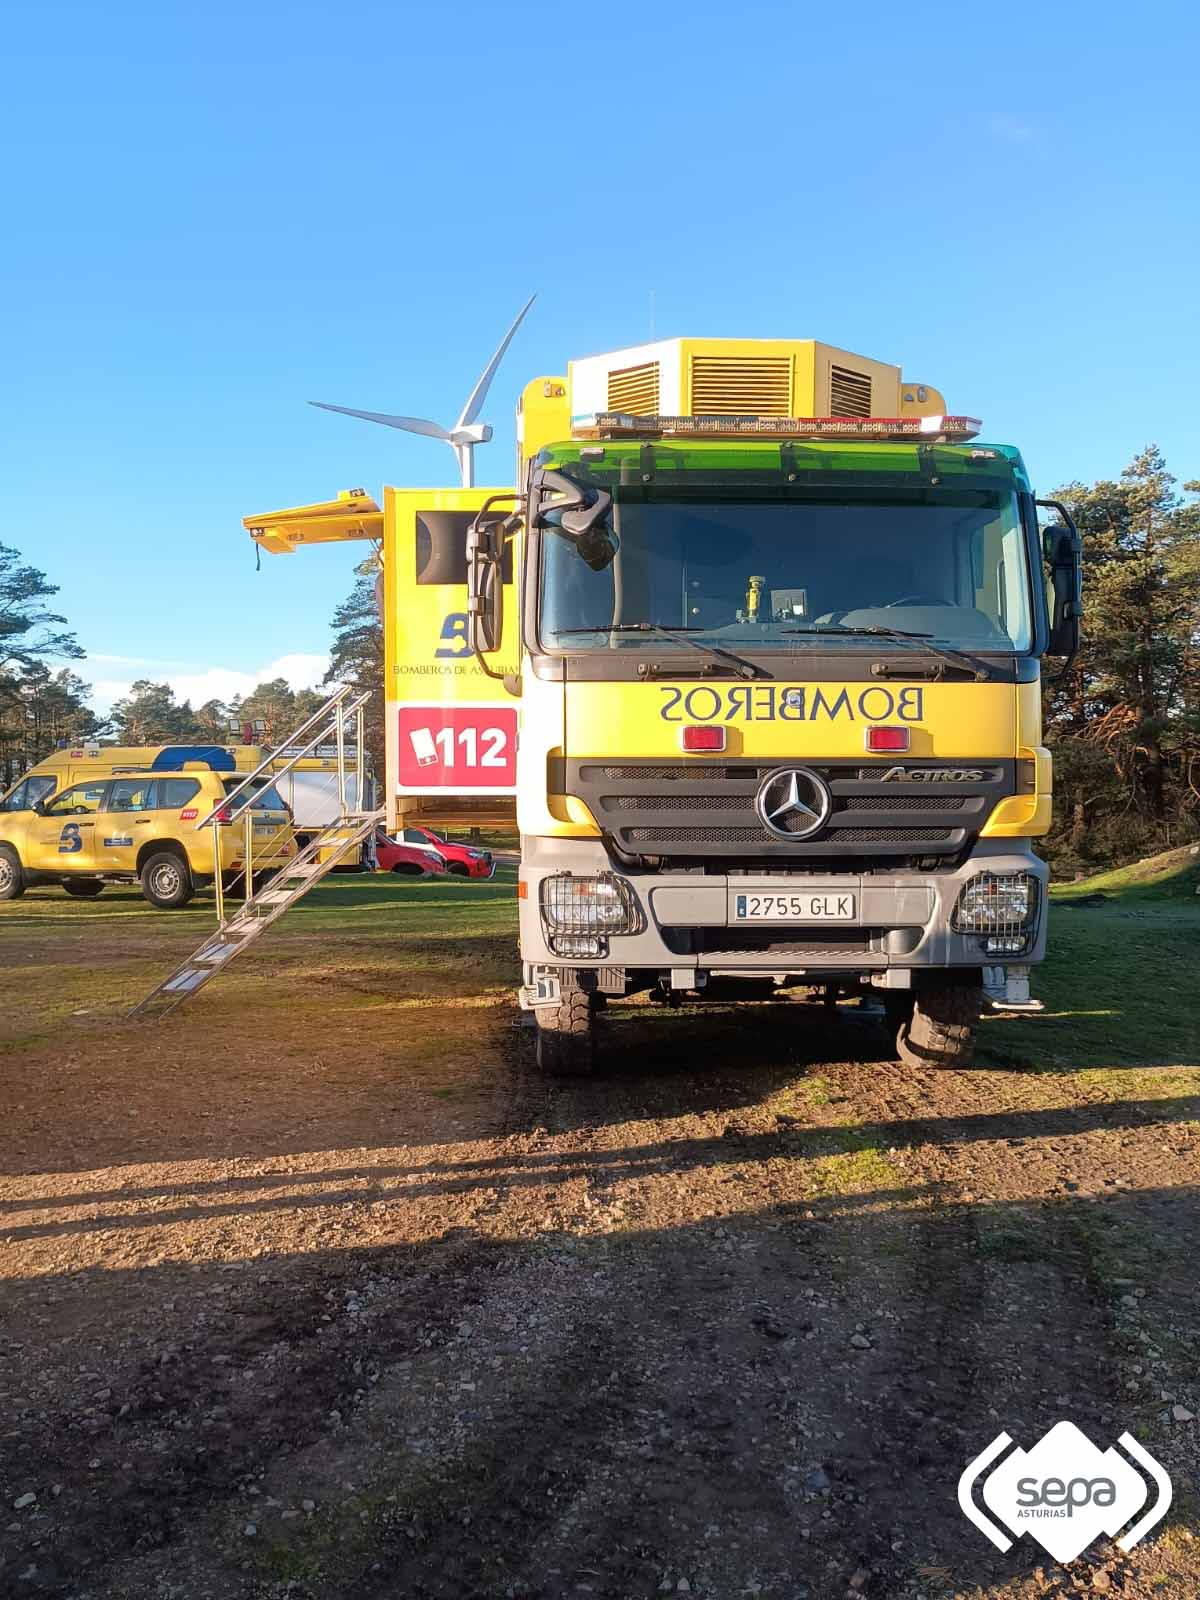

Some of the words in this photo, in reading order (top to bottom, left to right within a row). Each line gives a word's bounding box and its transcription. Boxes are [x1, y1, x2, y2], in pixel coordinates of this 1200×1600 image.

[393, 665, 452, 675] BOMBEROS
[454, 665, 468, 675] DE
[436, 727, 507, 768] 112
[749, 897, 802, 916] 2755
[810, 897, 849, 916] GLK
